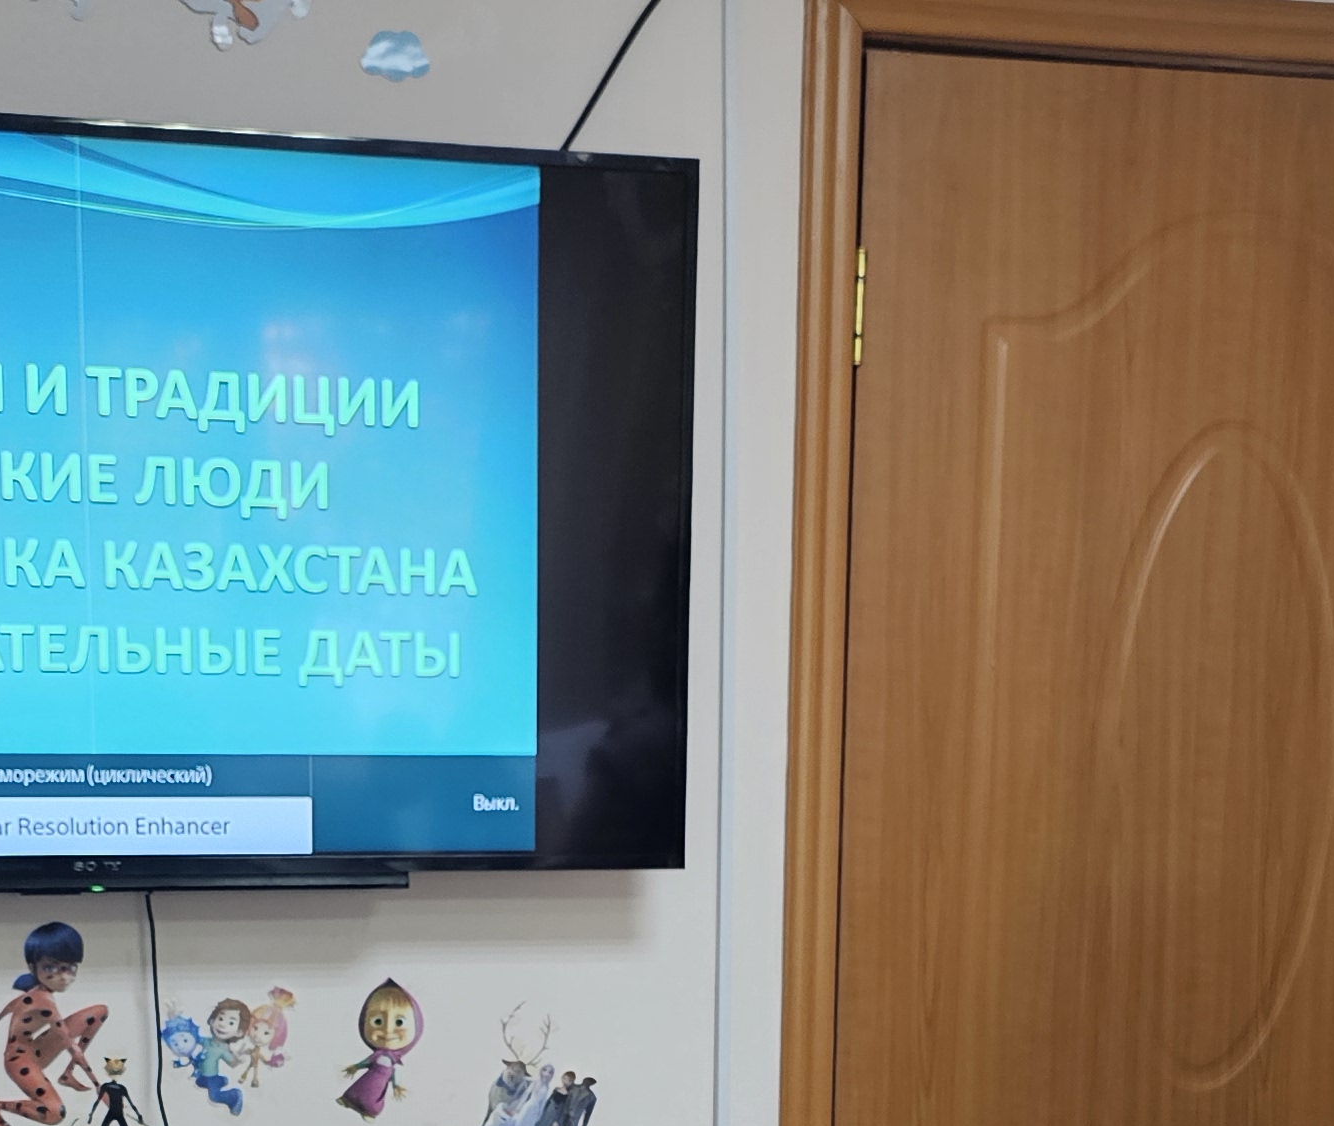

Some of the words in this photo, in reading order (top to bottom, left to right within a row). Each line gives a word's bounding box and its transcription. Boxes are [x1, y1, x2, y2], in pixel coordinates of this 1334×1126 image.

[25, 362, 67, 416] И
[85, 364, 421, 437] ТРАДИЦИИ
[134, 455, 331, 520] ЛЮДИ
[104, 540, 478, 597] КАЗАХСТАНА
[298, 628, 462, 687] ДАТЫ
[86, 763, 214, 787] (циклический)
[473, 793, 520, 811] Выкл.
[18, 817, 130, 838] Resolution
[135, 817, 231, 838] Enhancer
[73, 860, 123, 872] SOY
